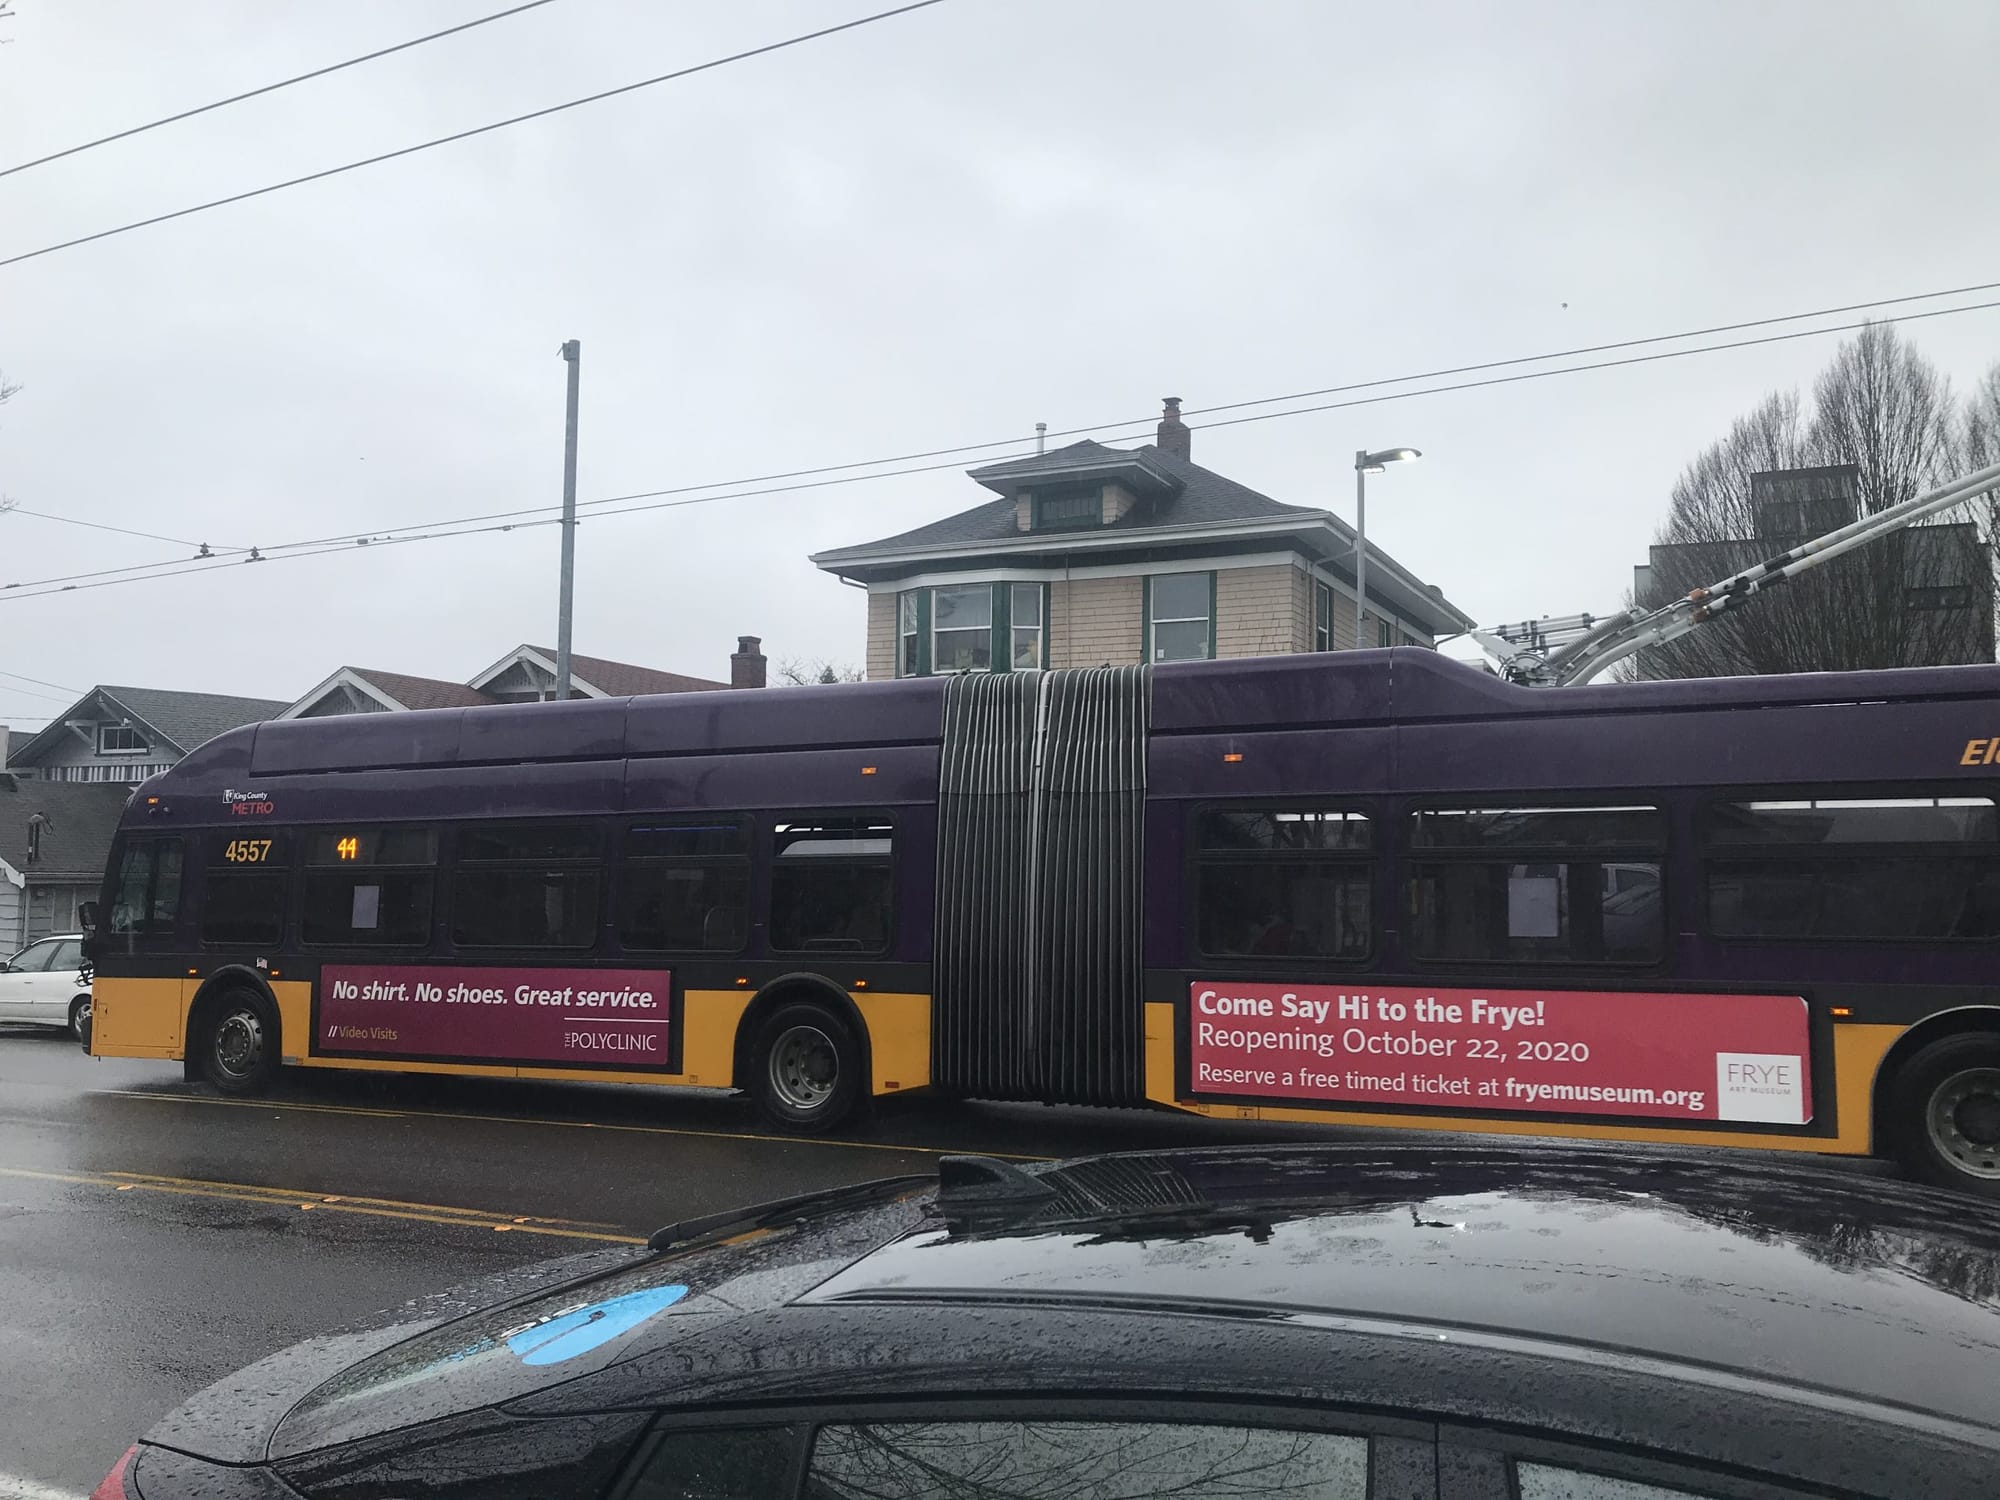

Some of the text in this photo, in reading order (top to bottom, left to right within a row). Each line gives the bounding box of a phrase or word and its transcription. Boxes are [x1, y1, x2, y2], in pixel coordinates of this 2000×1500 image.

[233, 791, 268, 801] King County
[232, 801, 274, 815] METRO
[225, 840, 273, 862] 4557
[337, 837, 357, 859] 44
[332, 980, 658, 1008] No shirt. No shoes. Great service.
[1199, 991, 1545, 1031] Come Say Hi to the Frye!
[339, 1025, 368, 1039] Video
[370, 1026, 398, 1040] Visits
[571, 1032, 657, 1051] POLYCLINIC
[1199, 1022, 1590, 1063] Reopening October 22, 2020
[1728, 1063, 1791, 1085] FRYE
[1199, 1062, 1705, 1111] Reserve a free timed ticket at fryemuseum.org
[1750, 1087, 1791, 1095] MUSEUM
